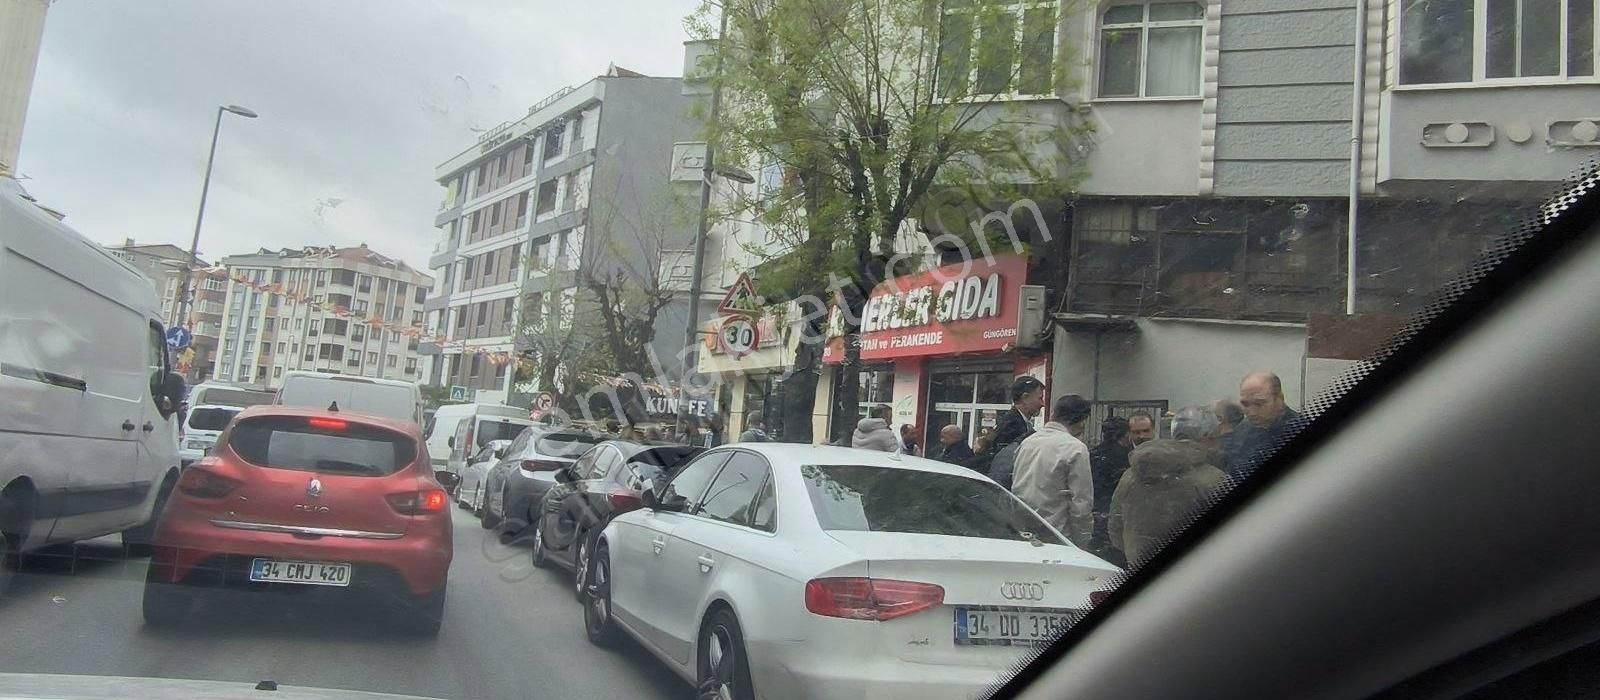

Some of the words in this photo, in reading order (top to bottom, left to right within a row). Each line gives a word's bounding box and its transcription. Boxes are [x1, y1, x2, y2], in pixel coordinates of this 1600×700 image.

[936, 272, 1000, 323] GIDA
[725, 325, 753, 347] 30
[879, 340, 888, 349] ve
[890, 331, 943, 349] PERAKENDE
[983, 327, 1017, 339] GÜNGÖREN
[645, 394, 708, 417] KÜNFE
[262, 562, 280, 578] 34
[286, 563, 314, 580] CMJ
[319, 565, 346, 582] 420
[969, 614, 989, 636] 34
